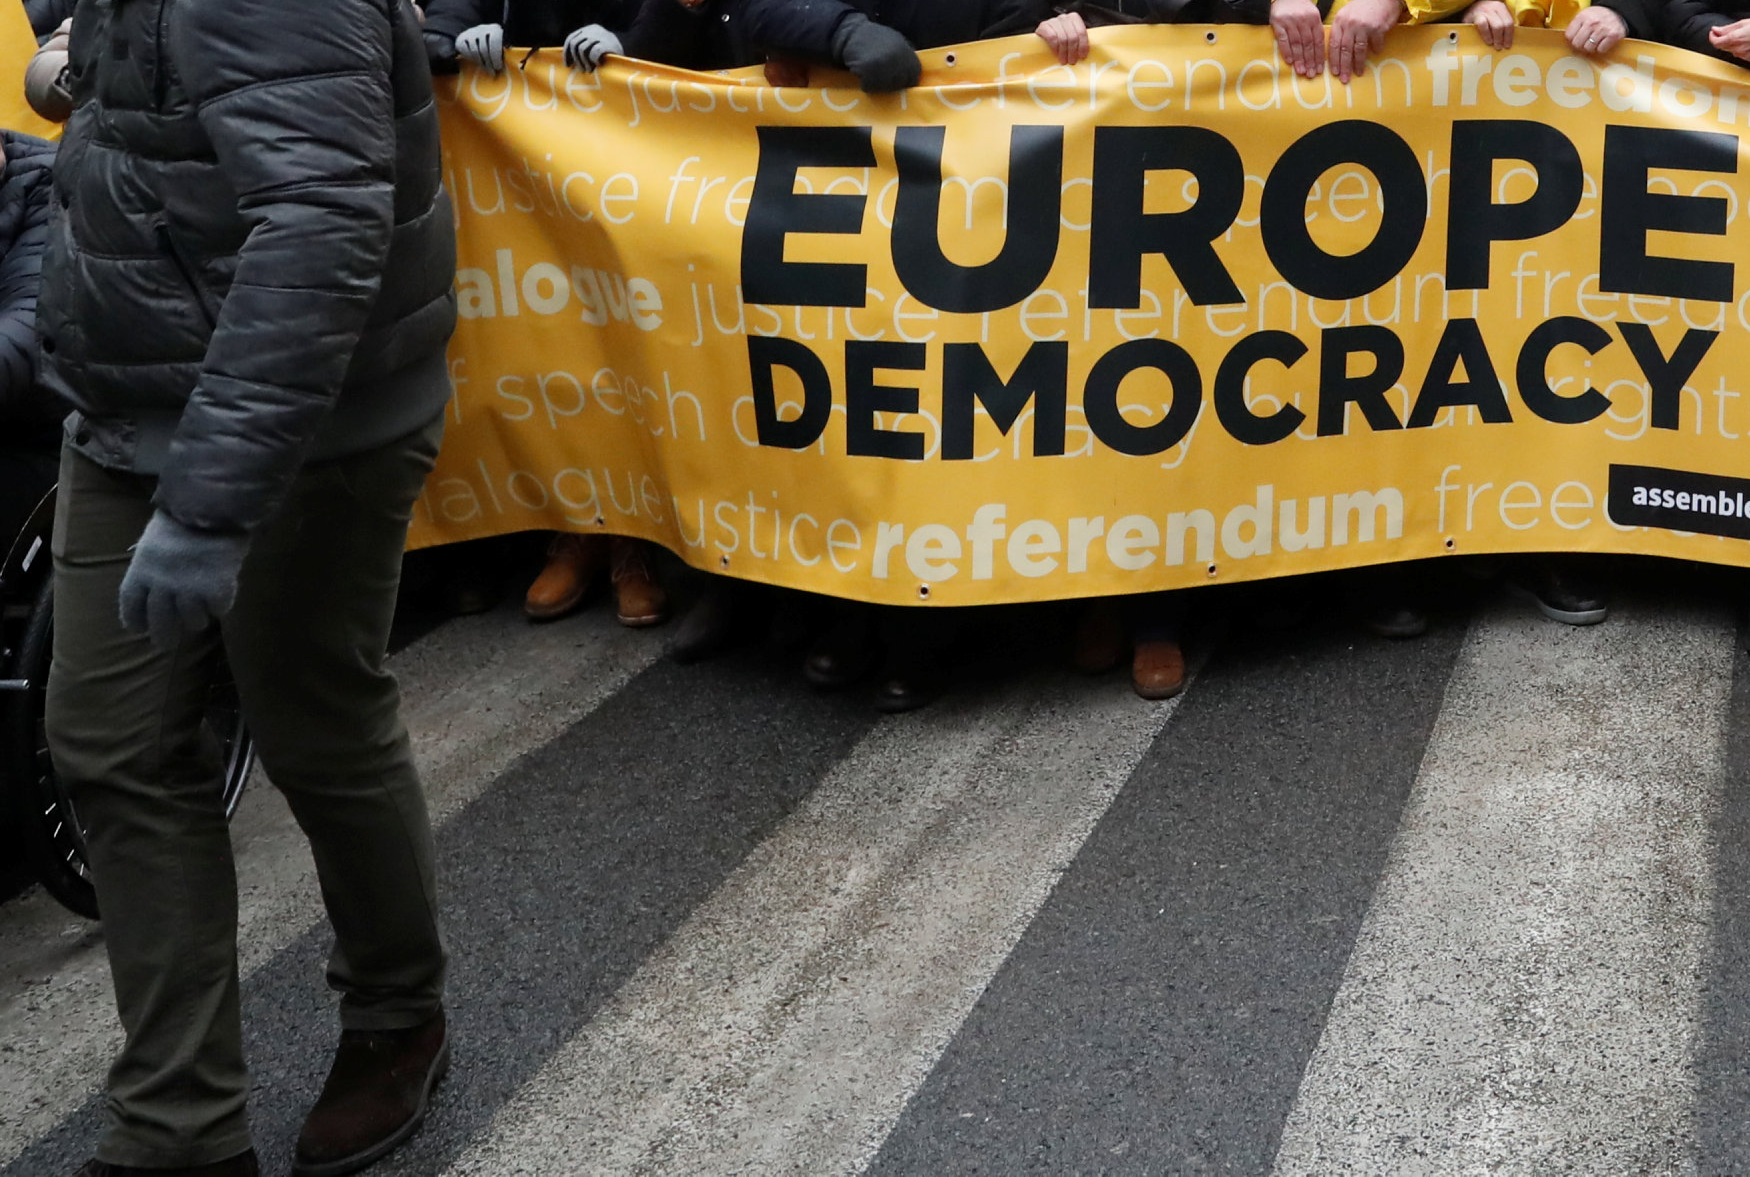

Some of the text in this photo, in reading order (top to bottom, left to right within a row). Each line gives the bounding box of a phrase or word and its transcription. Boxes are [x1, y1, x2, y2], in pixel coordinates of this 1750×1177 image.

[741, 119, 1740, 315] EUROPE
[457, 247, 663, 331] alogue
[747, 316, 1721, 461] DEMOCRACY
[674, 490, 862, 574] ustice
[872, 483, 1404, 581] referendum
